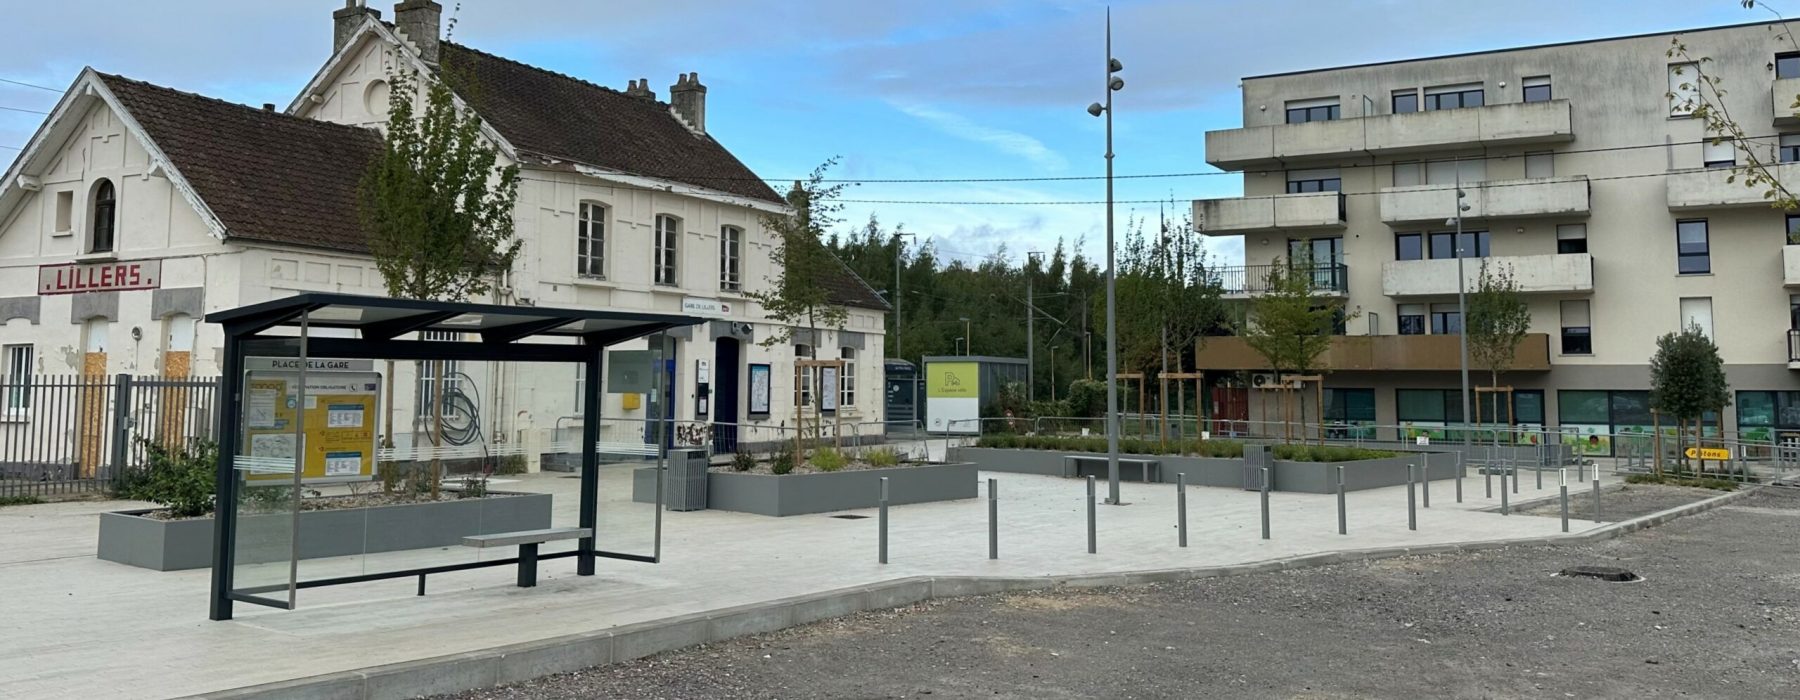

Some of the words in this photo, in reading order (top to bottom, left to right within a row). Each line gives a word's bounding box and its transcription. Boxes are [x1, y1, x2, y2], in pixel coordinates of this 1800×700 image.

[272, 360, 299, 368] PLACE
[315, 361, 325, 369] LA
[327, 361, 349, 369] GARE
